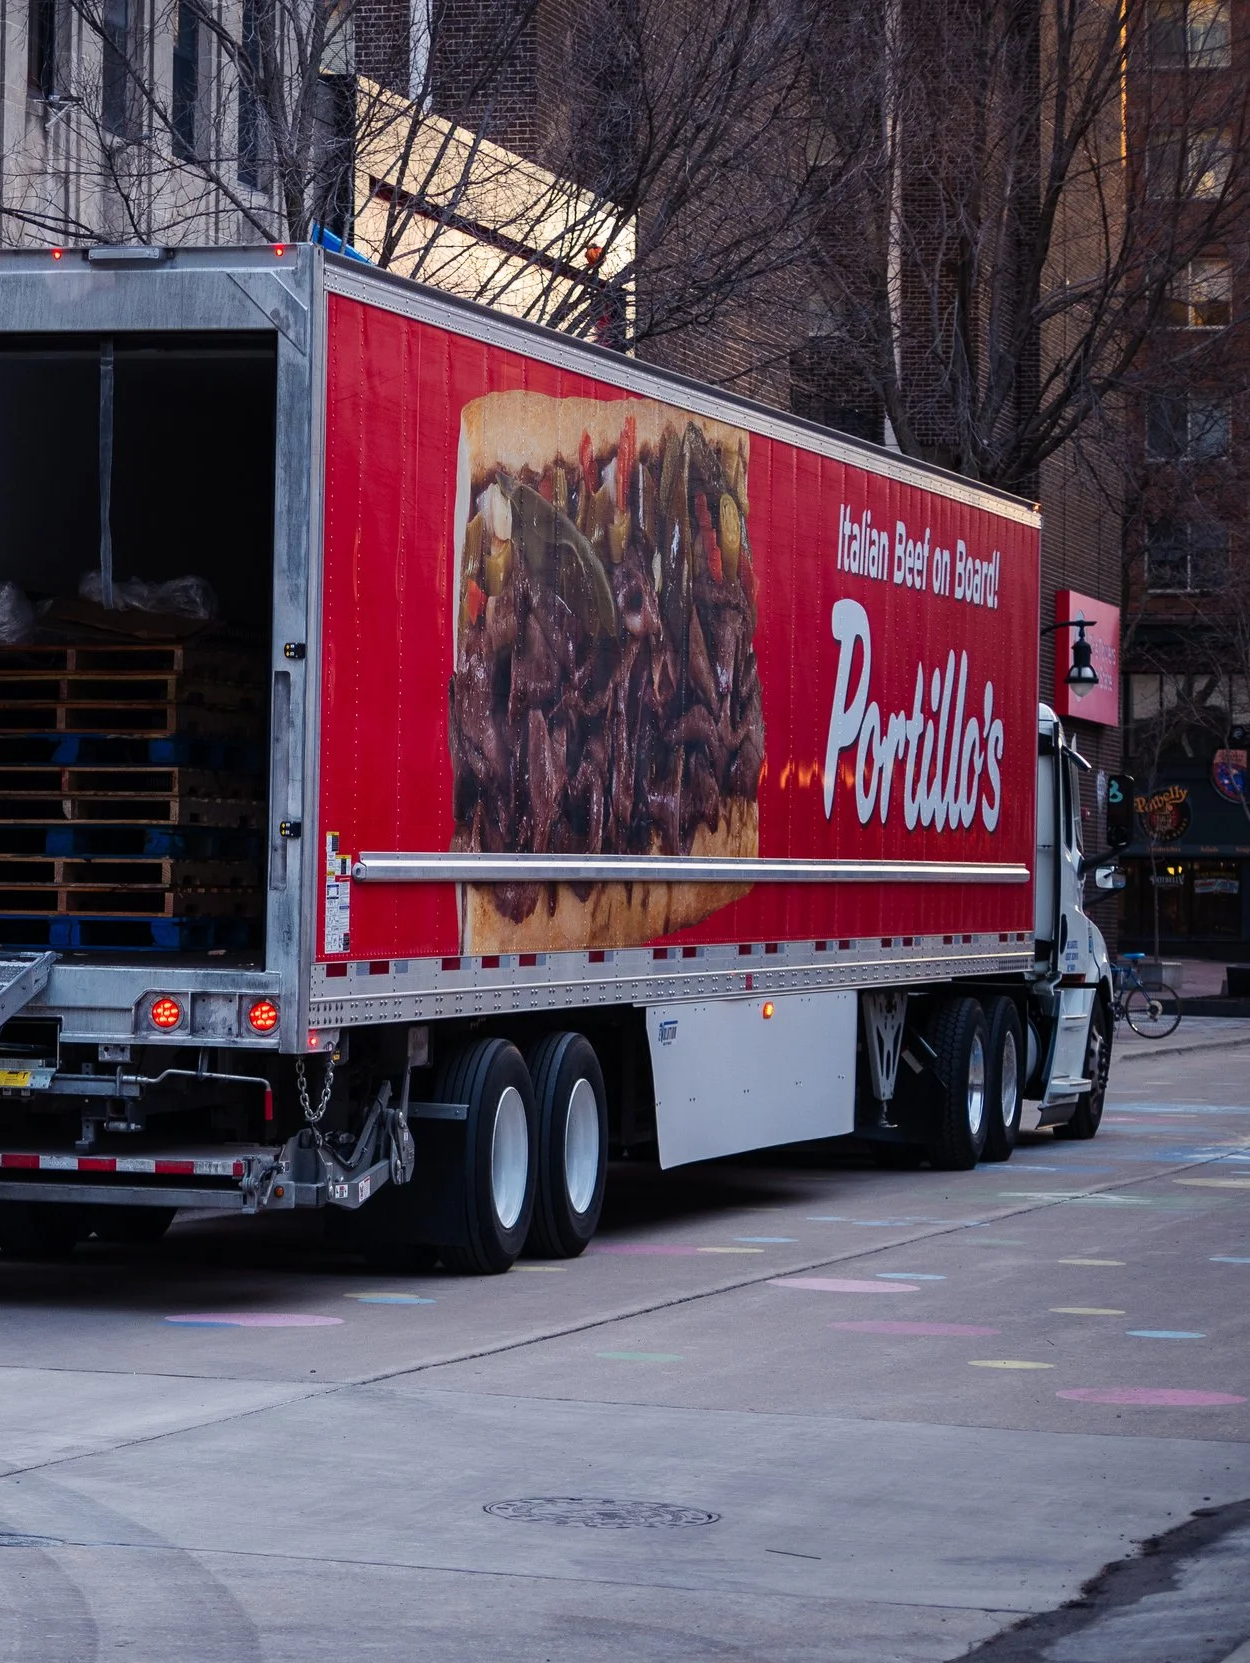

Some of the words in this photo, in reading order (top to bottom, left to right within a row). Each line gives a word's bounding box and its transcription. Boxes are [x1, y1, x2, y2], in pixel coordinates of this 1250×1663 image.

[837, 503, 889, 581] Italian
[893, 520, 931, 591] Beef
[932, 546, 951, 597] on
[954, 538, 1001, 610] Board!
[823, 597, 1004, 833] Portillo's
